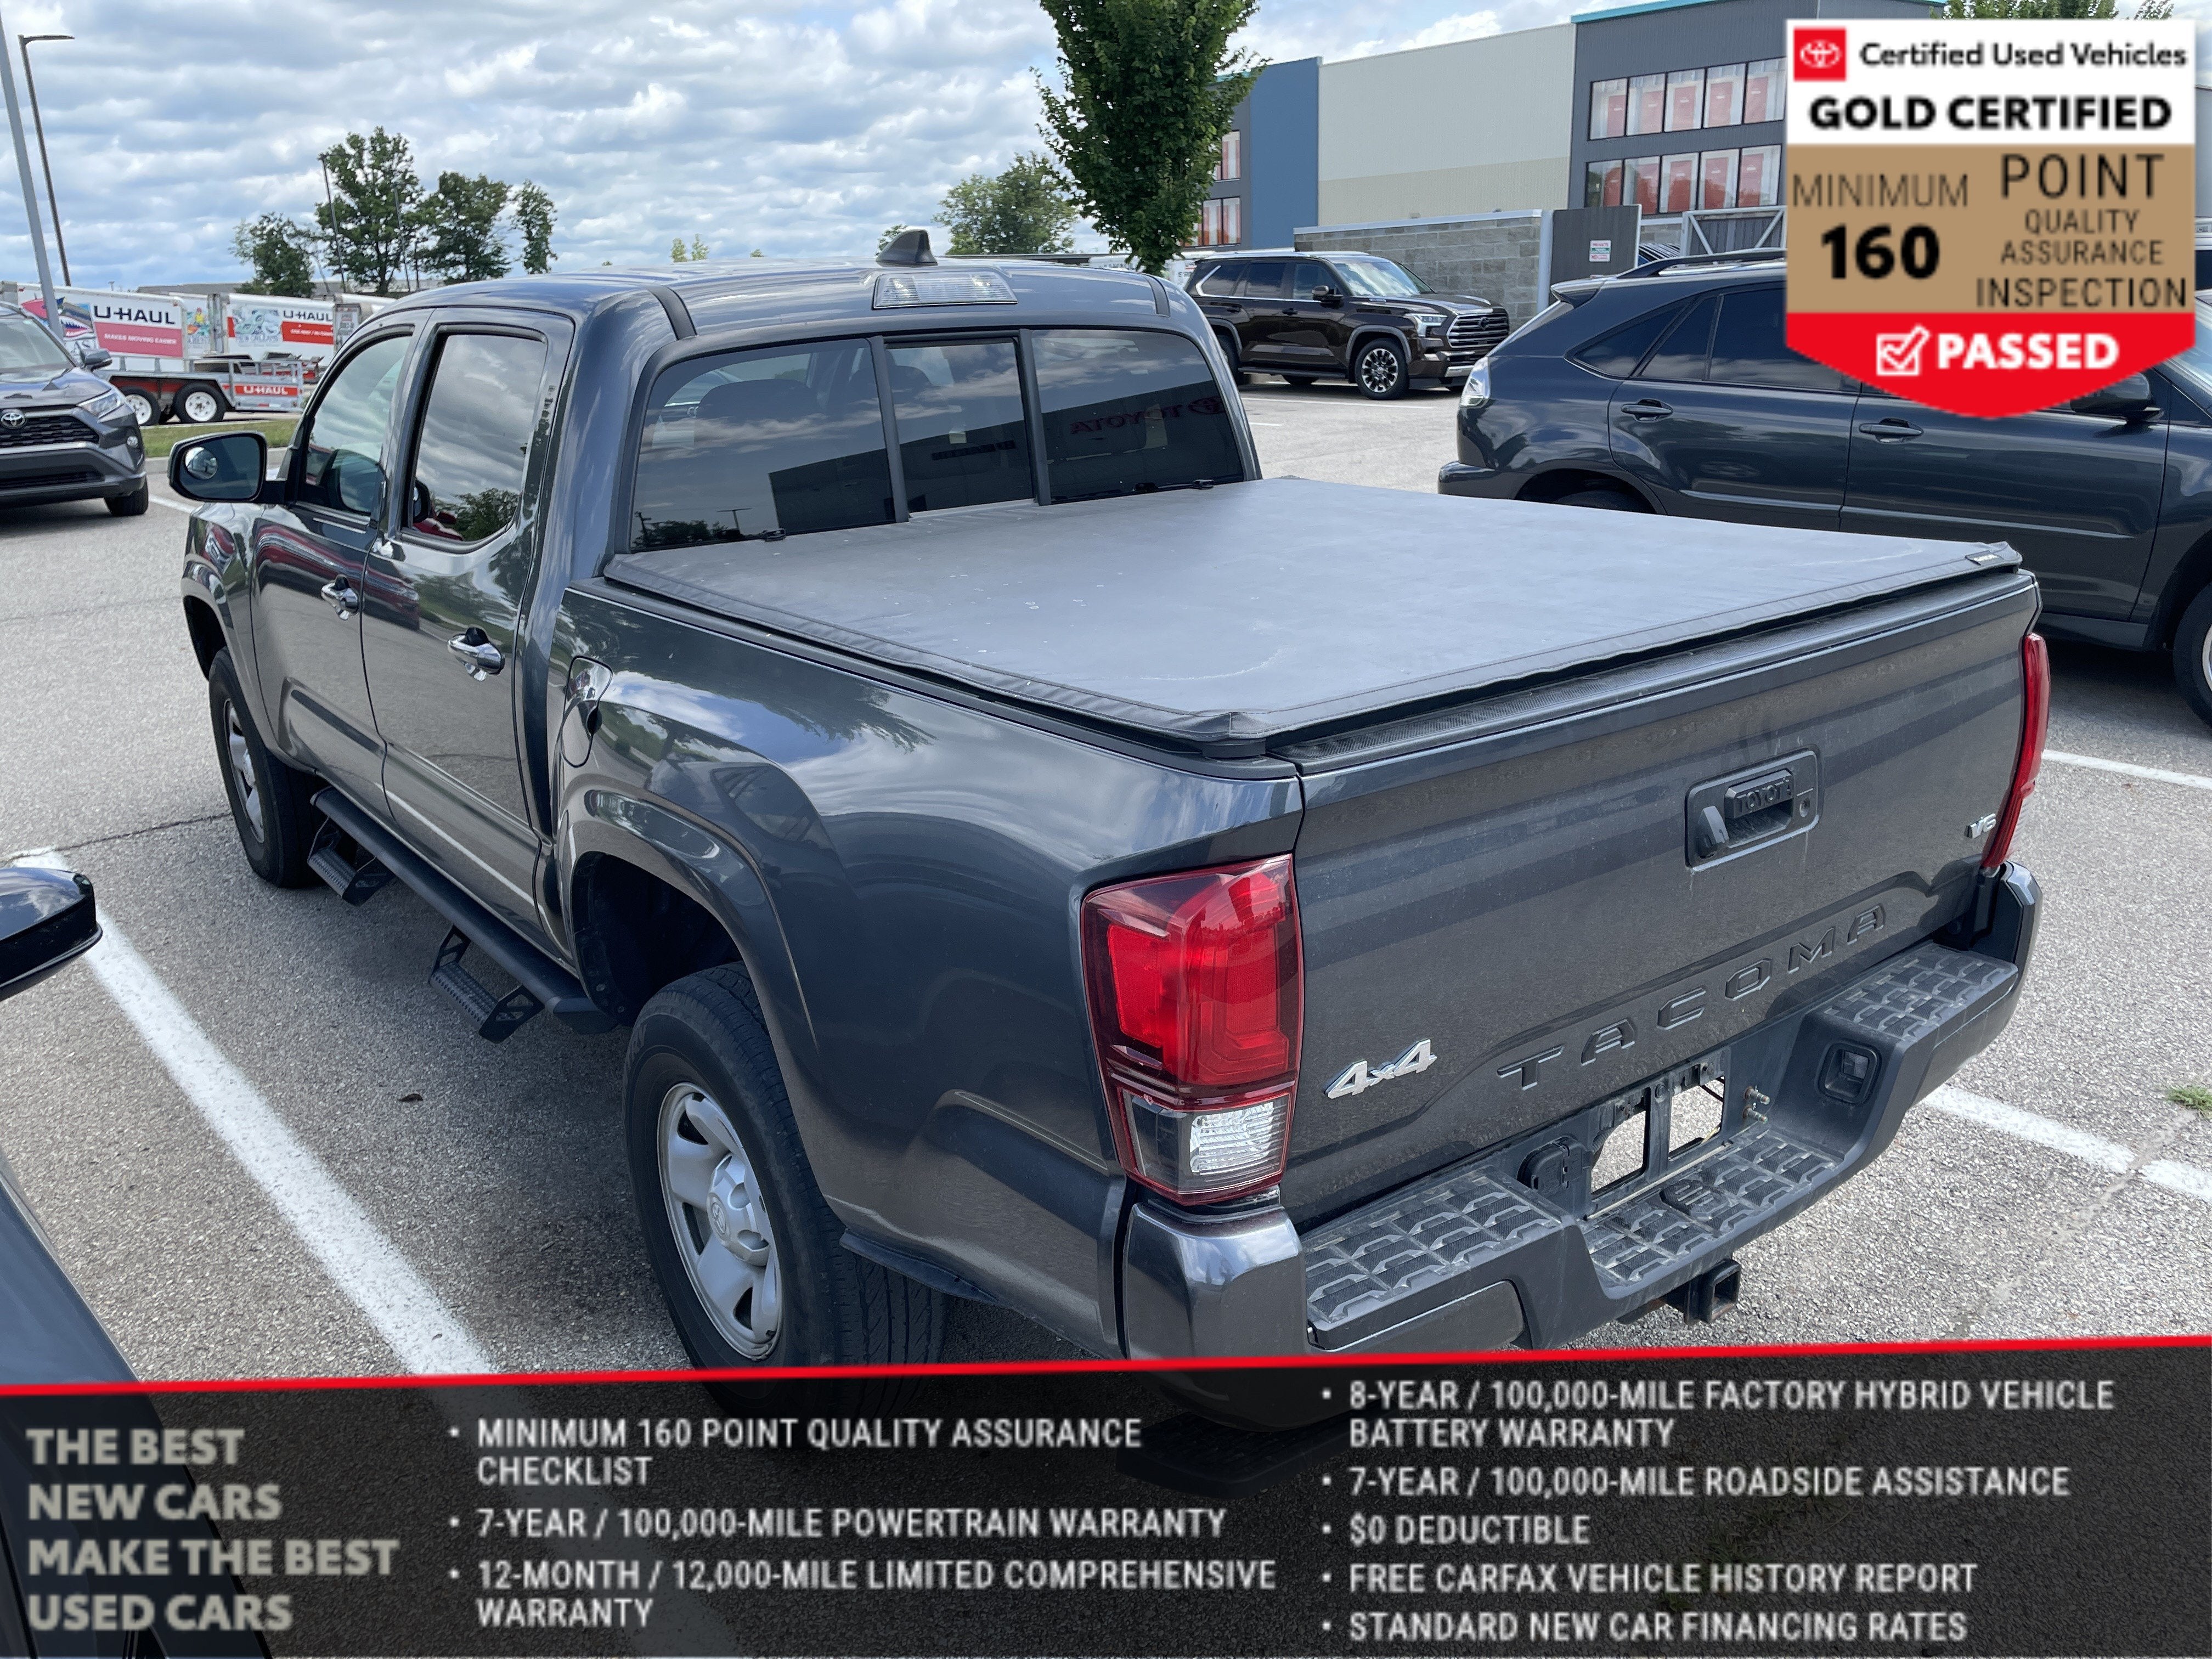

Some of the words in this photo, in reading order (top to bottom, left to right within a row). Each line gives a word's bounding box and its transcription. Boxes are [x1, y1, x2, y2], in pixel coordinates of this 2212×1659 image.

[93, 305, 175, 325] U-HAUL
[283, 309, 333, 321] U-HAUL
[127, 335, 154, 343] MOVING
[155, 337, 177, 345] EASIER
[243, 385, 288, 395] U-HAUL
[1736, 777, 1793, 814] TOYOTA
[1965, 812, 1997, 839] V6
[1496, 905, 1885, 1091] TACOMA
[1324, 1038, 1438, 1099] 4x4
